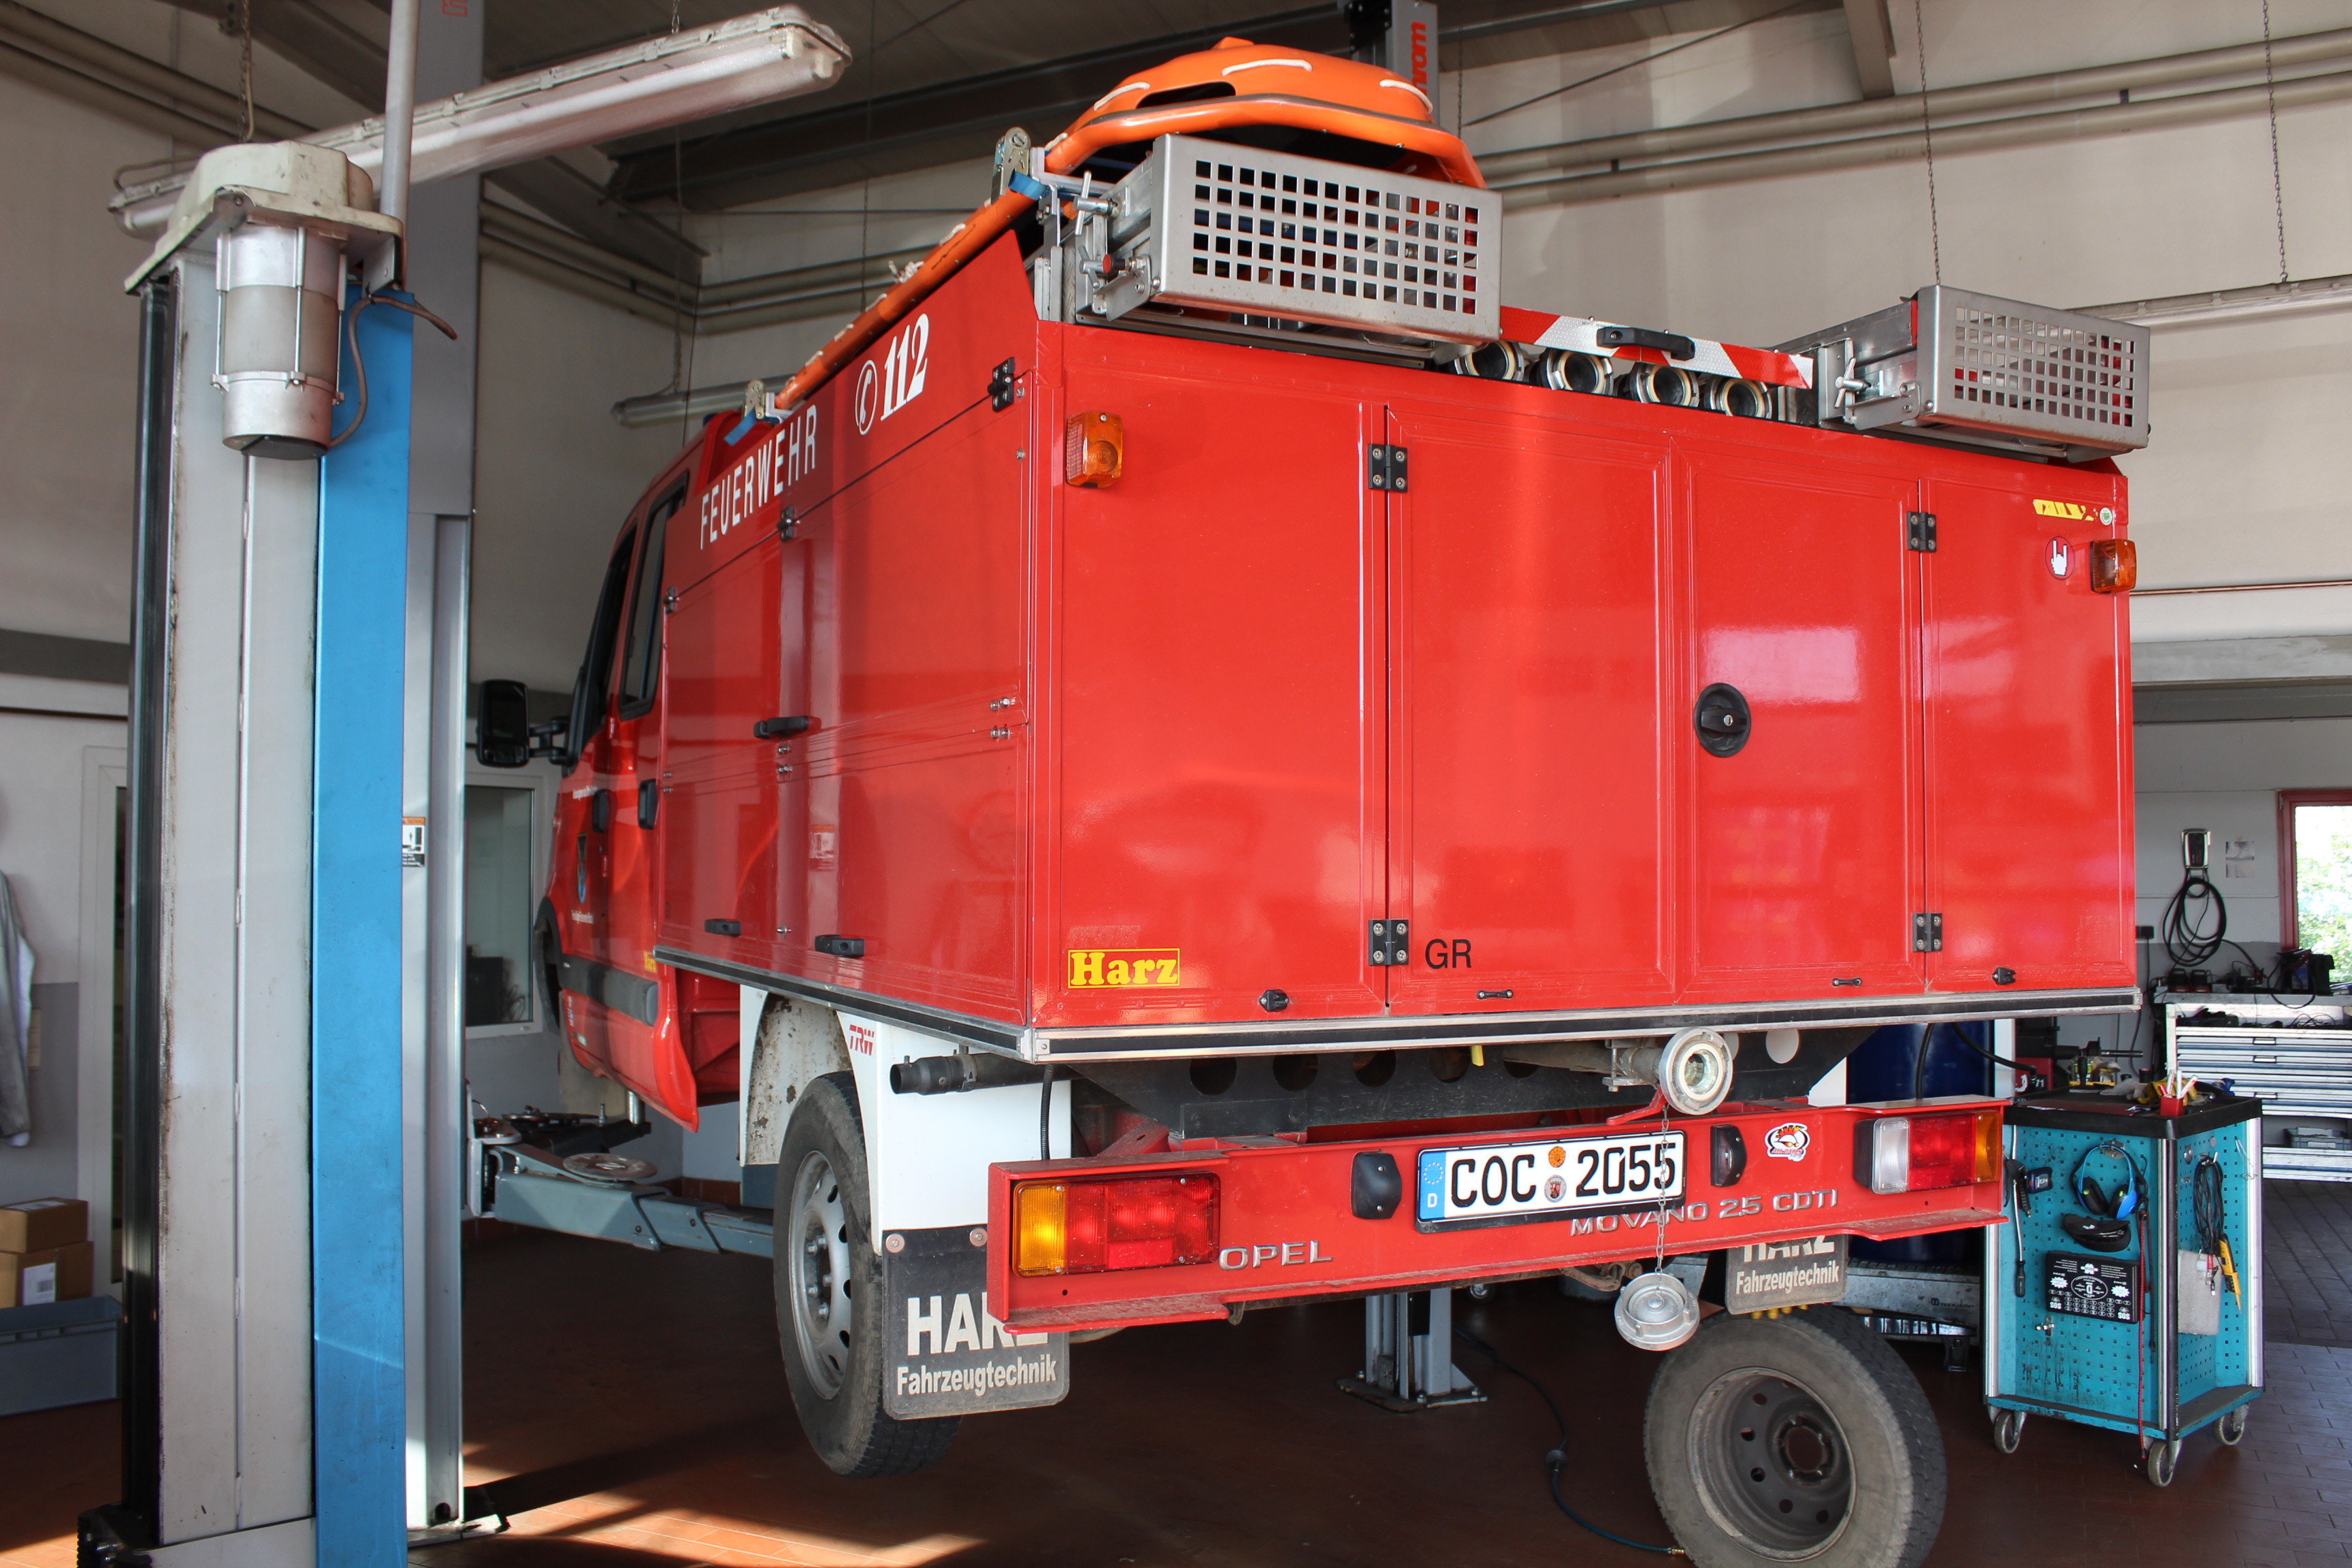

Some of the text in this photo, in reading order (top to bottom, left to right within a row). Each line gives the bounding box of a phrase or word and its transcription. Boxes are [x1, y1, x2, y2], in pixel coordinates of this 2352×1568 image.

[881, 313, 930, 421] 112
[700, 404, 817, 550] FEUERWEHR
[1071, 952, 1178, 985] Harz
[1425, 938, 1472, 970] GR
[849, 1024, 875, 1056] TRW
[1451, 1143, 1676, 1208] COC 2055
[1427, 1193, 1438, 1208] D
[1570, 1202, 1710, 1237] MOVANO
[1772, 1189, 1838, 1211] CDTI
[1218, 1240, 1334, 1271] OPEL
[1736, 1260, 1840, 1294] Fahrzeugtechnik
[907, 1292, 1048, 1356] HAR
[897, 1354, 1057, 1396] Fahrzeugtechnik
